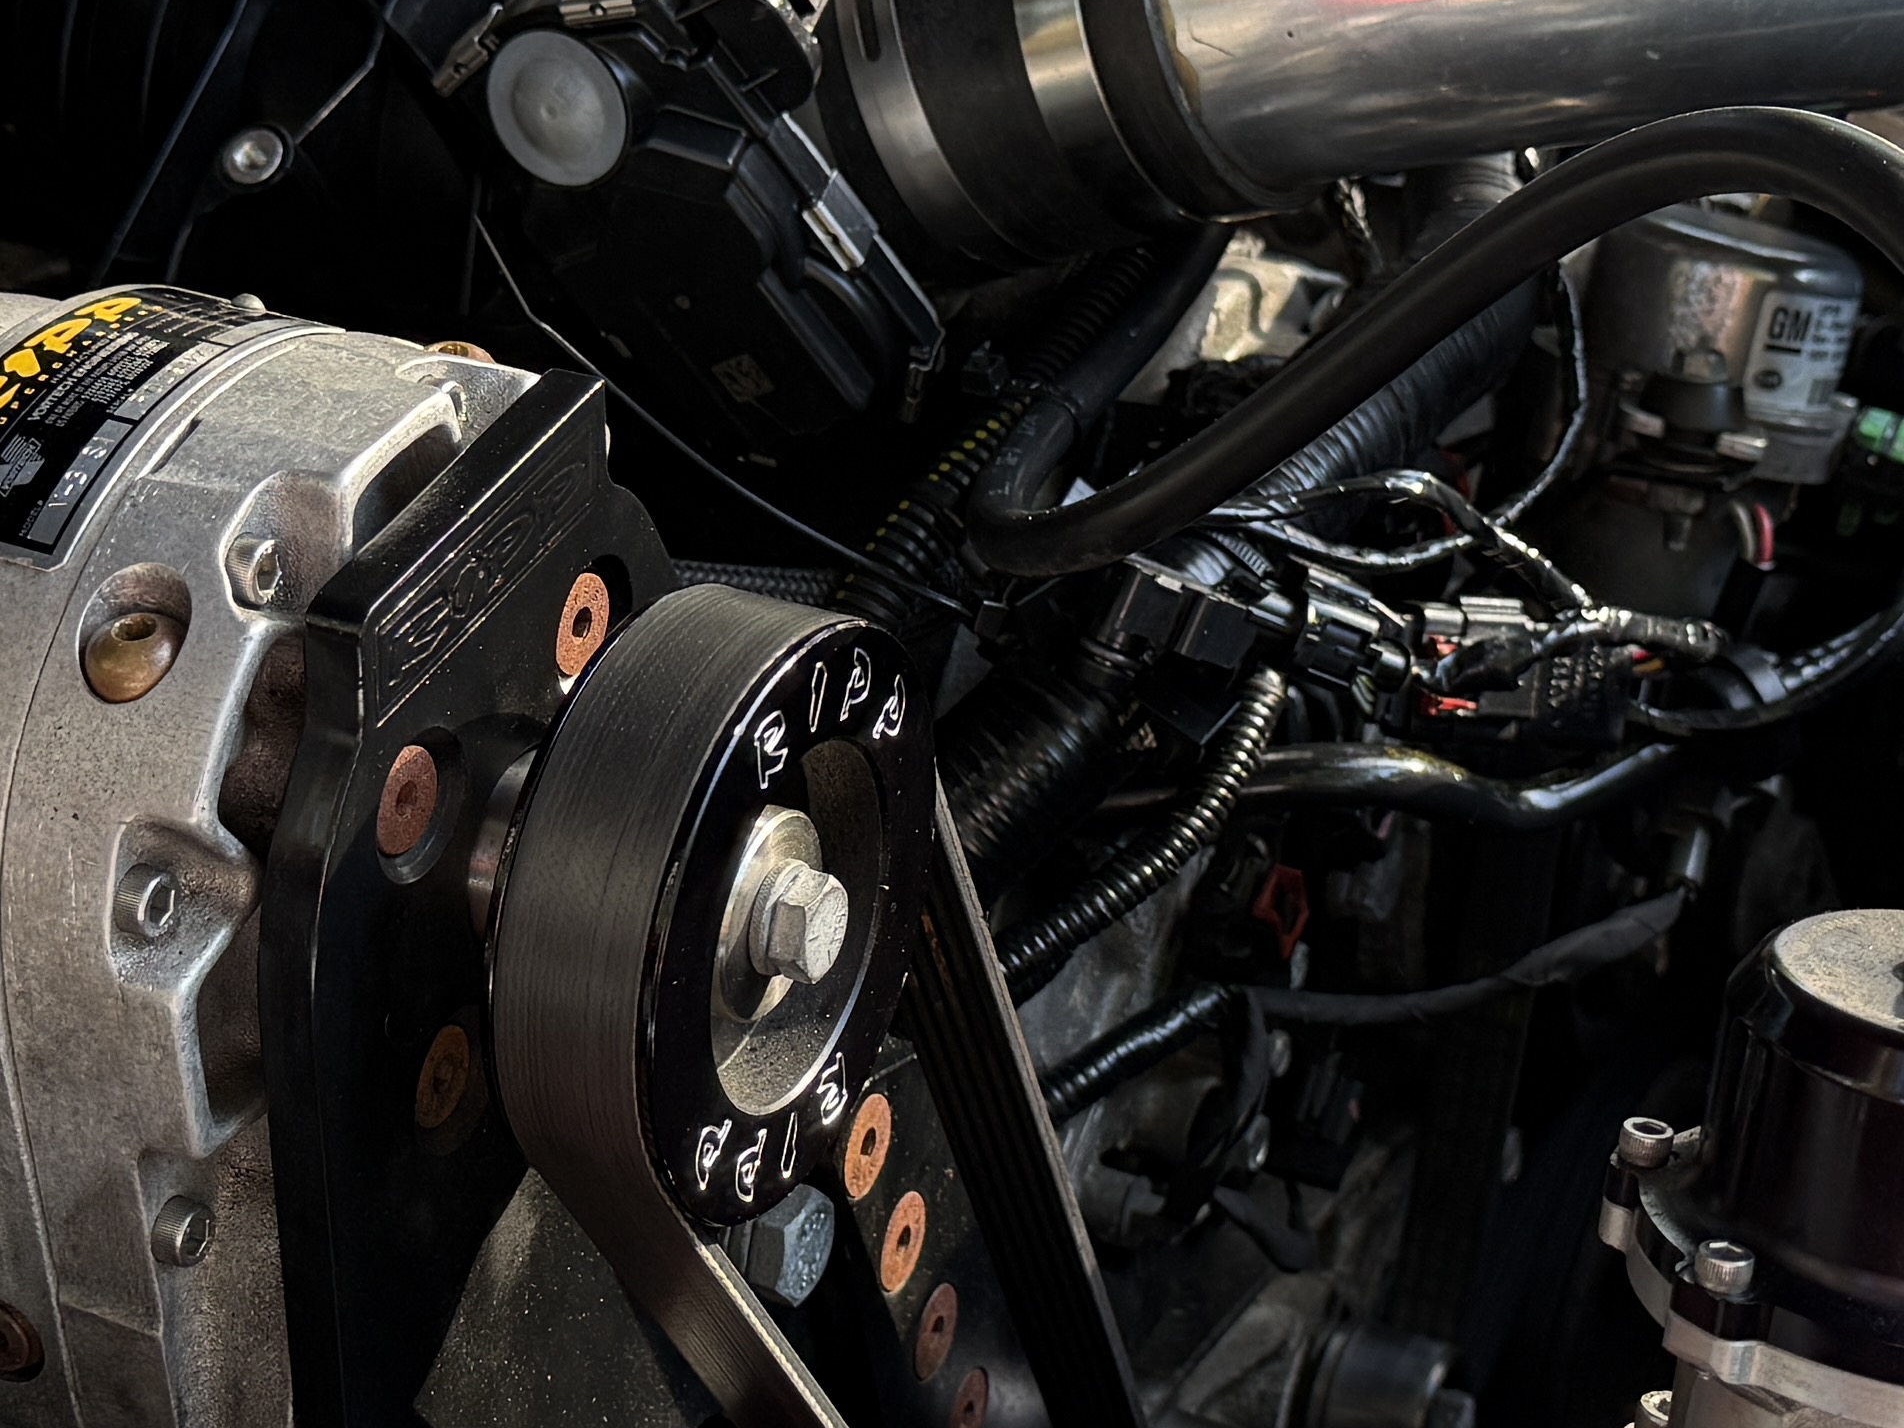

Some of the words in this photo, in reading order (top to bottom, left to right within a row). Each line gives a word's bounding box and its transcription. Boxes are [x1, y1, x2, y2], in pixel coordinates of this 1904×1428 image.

[1767, 307, 1813, 341] GM
[753, 647, 907, 790] RIPP
[694, 1051, 849, 1203] RIPP
